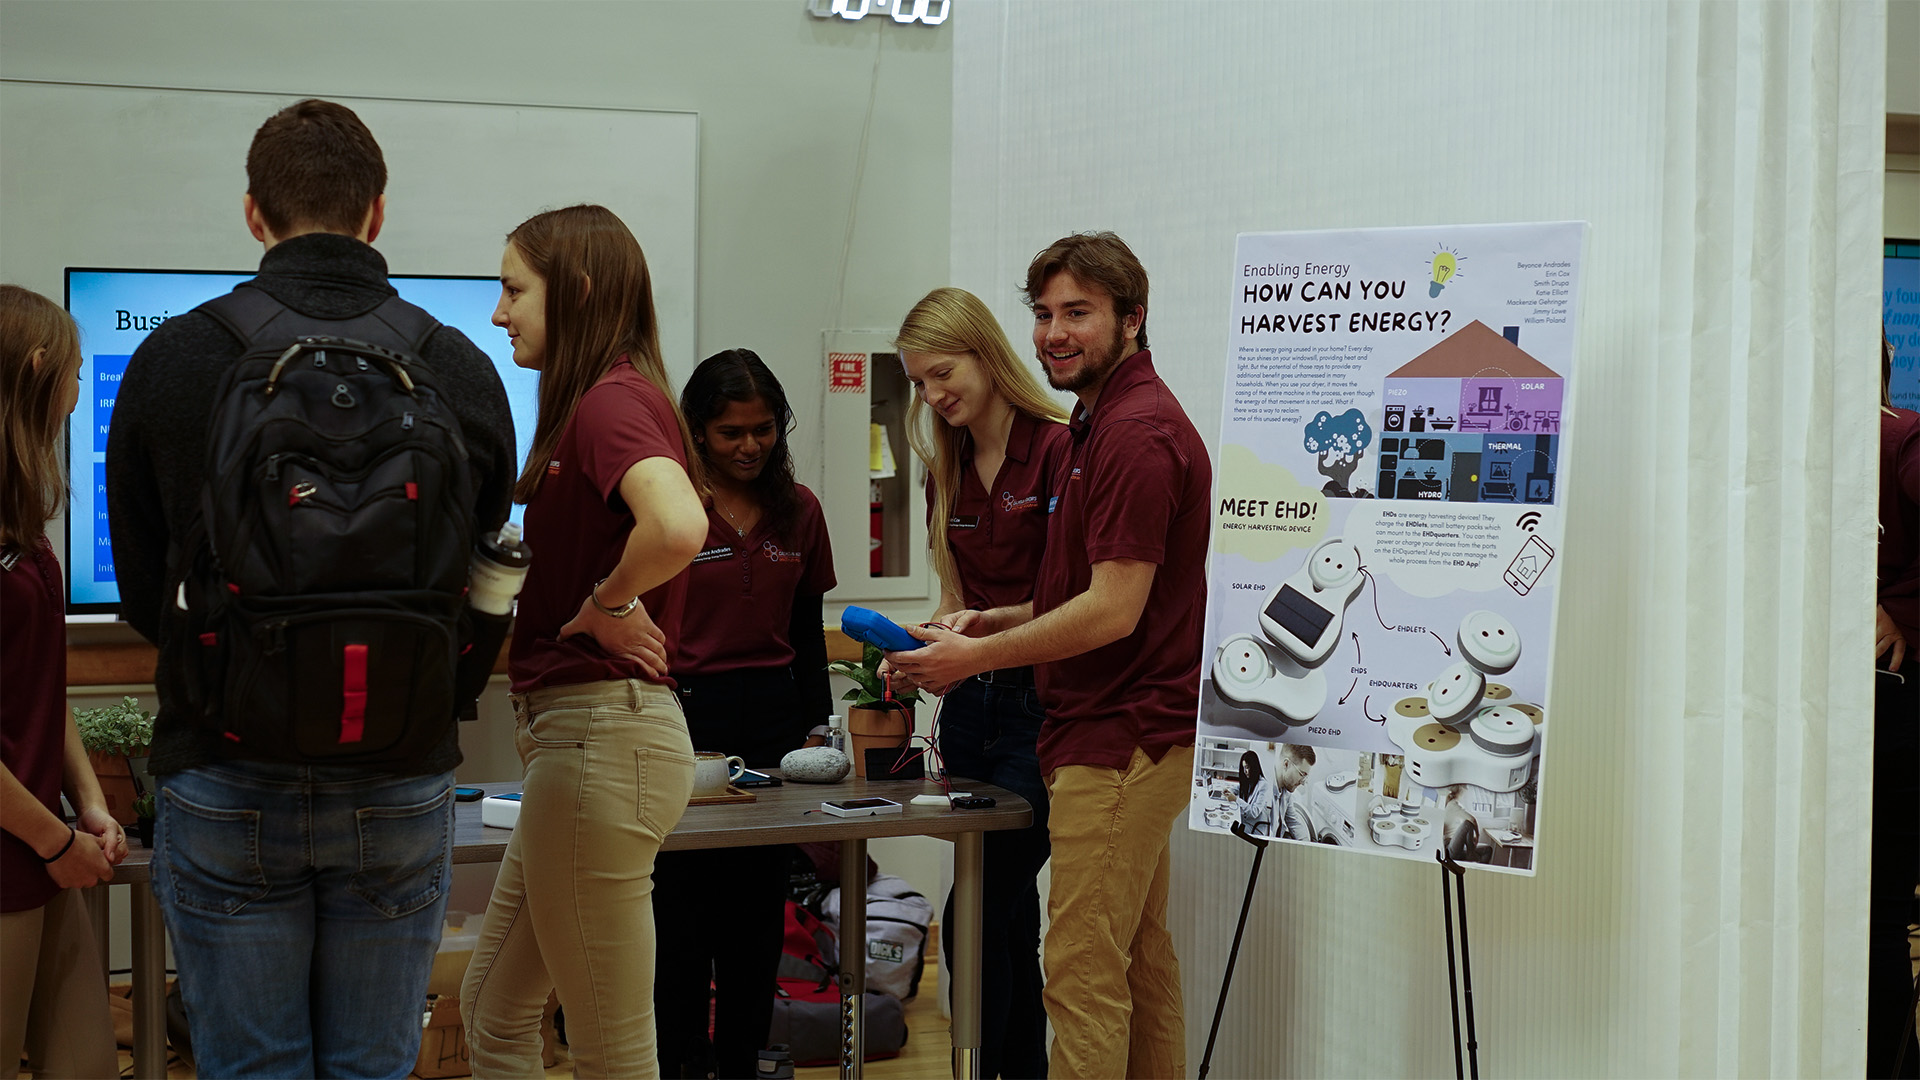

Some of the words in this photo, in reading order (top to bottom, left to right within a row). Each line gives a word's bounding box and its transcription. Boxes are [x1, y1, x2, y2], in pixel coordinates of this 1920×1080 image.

[1244, 264, 1300, 279] Enabling
[1304, 262, 1350, 278] Energy
[1244, 282, 1293, 303] HOW
[1300, 281, 1351, 302] CAN
[1360, 280, 1406, 300] YOU
[115, 310, 174, 331] Busi
[1241, 313, 1341, 334] HARVEST
[1349, 310, 1452, 333] ENERGY?
[840, 362, 856, 372] FIRE
[100, 372, 124, 382] Brea
[1282, 416, 1302, 424] energy?
[1220, 498, 1269, 517] MEET
[1275, 501, 1317, 520] EHD!
[98, 511, 109, 520] In
[1428, 513, 1456, 521] harvesting
[1482, 514, 1495, 522] They
[1446, 522, 1465, 531] battery
[1402, 539, 1421, 547] charge
[98, 564, 114, 572] Init
[1397, 625, 1426, 633] EHDLETS
[1369, 680, 1417, 690] EHDQUARTERS
